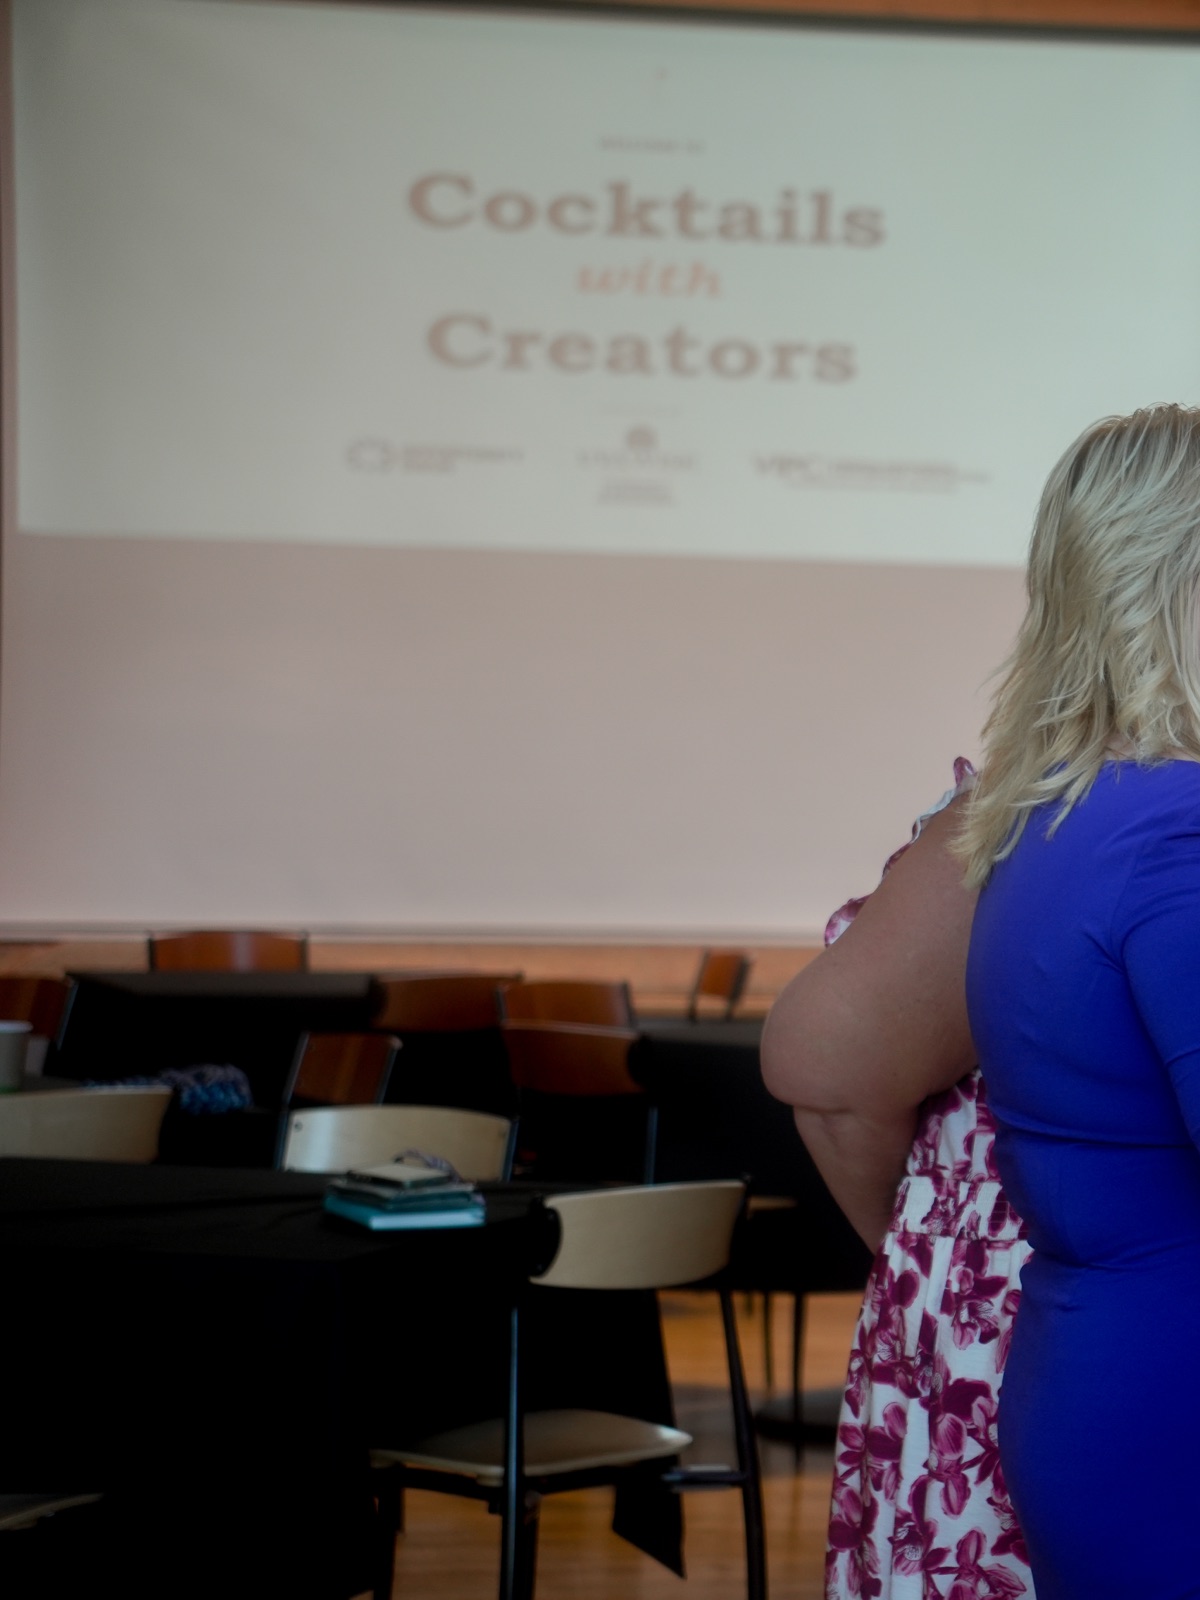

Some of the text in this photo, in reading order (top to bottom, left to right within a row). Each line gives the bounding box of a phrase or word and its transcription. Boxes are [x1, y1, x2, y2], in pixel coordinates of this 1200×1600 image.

[407, 171, 886, 248] Cocktails
[575, 258, 722, 297] with
[427, 312, 858, 384] Creators
